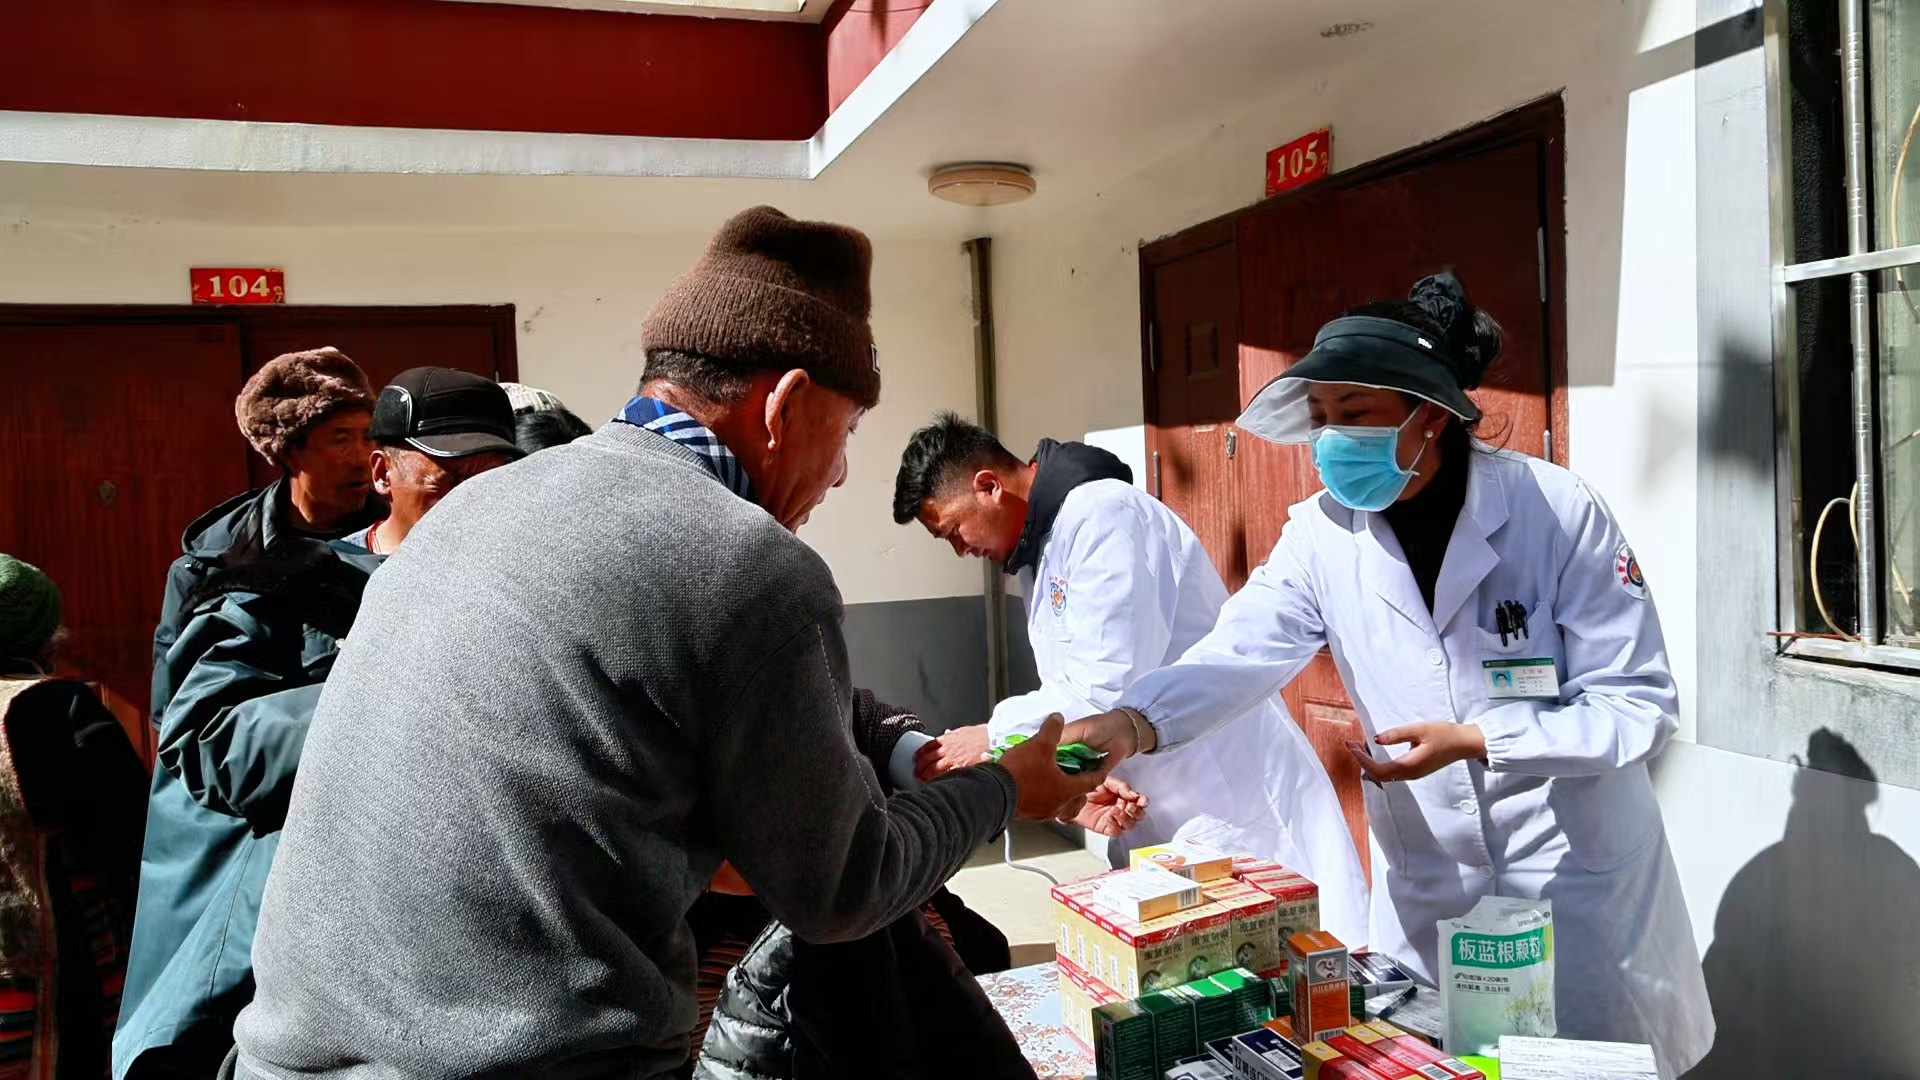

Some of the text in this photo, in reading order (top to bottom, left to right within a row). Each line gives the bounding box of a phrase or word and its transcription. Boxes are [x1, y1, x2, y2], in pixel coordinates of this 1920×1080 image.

[1278, 139, 1318, 184] 105
[209, 275, 270, 297] 104
[1458, 936, 1541, 963] 板蓝根颗粒
